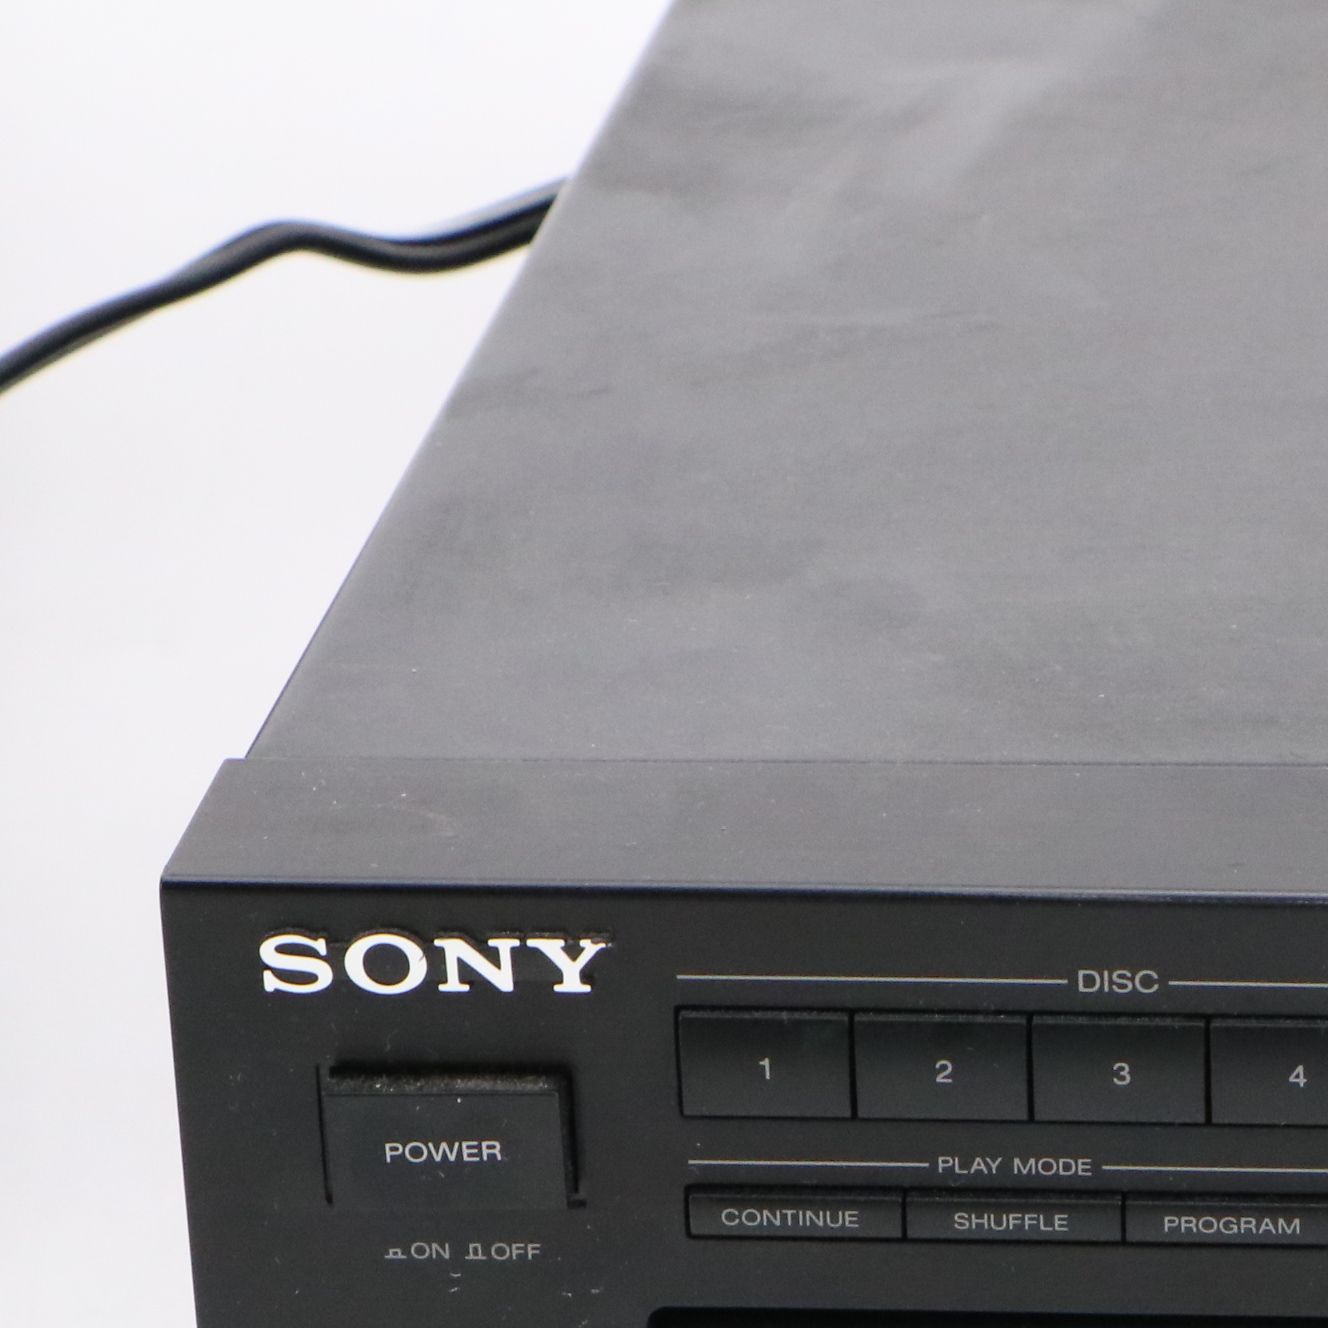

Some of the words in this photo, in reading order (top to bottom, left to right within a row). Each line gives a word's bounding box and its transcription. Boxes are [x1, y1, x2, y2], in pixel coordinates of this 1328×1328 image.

[259, 933, 607, 995] SONY
[1077, 969, 1159, 994] DISC
[759, 1057, 771, 1080] 1
[935, 1059, 953, 1083] 2
[1112, 1062, 1131, 1086] 3
[1288, 1064, 1308, 1088] 4
[384, 1140, 502, 1163] POWER
[937, 1156, 1003, 1176] PLAY
[1013, 1157, 1092, 1177] MODE
[721, 1208, 859, 1228] CONTINUE
[953, 1212, 1069, 1231] SHUFFLE
[1163, 1216, 1300, 1235] PROGRAM
[410, 1241, 450, 1260] ON
[490, 1242, 541, 1261] OFF
